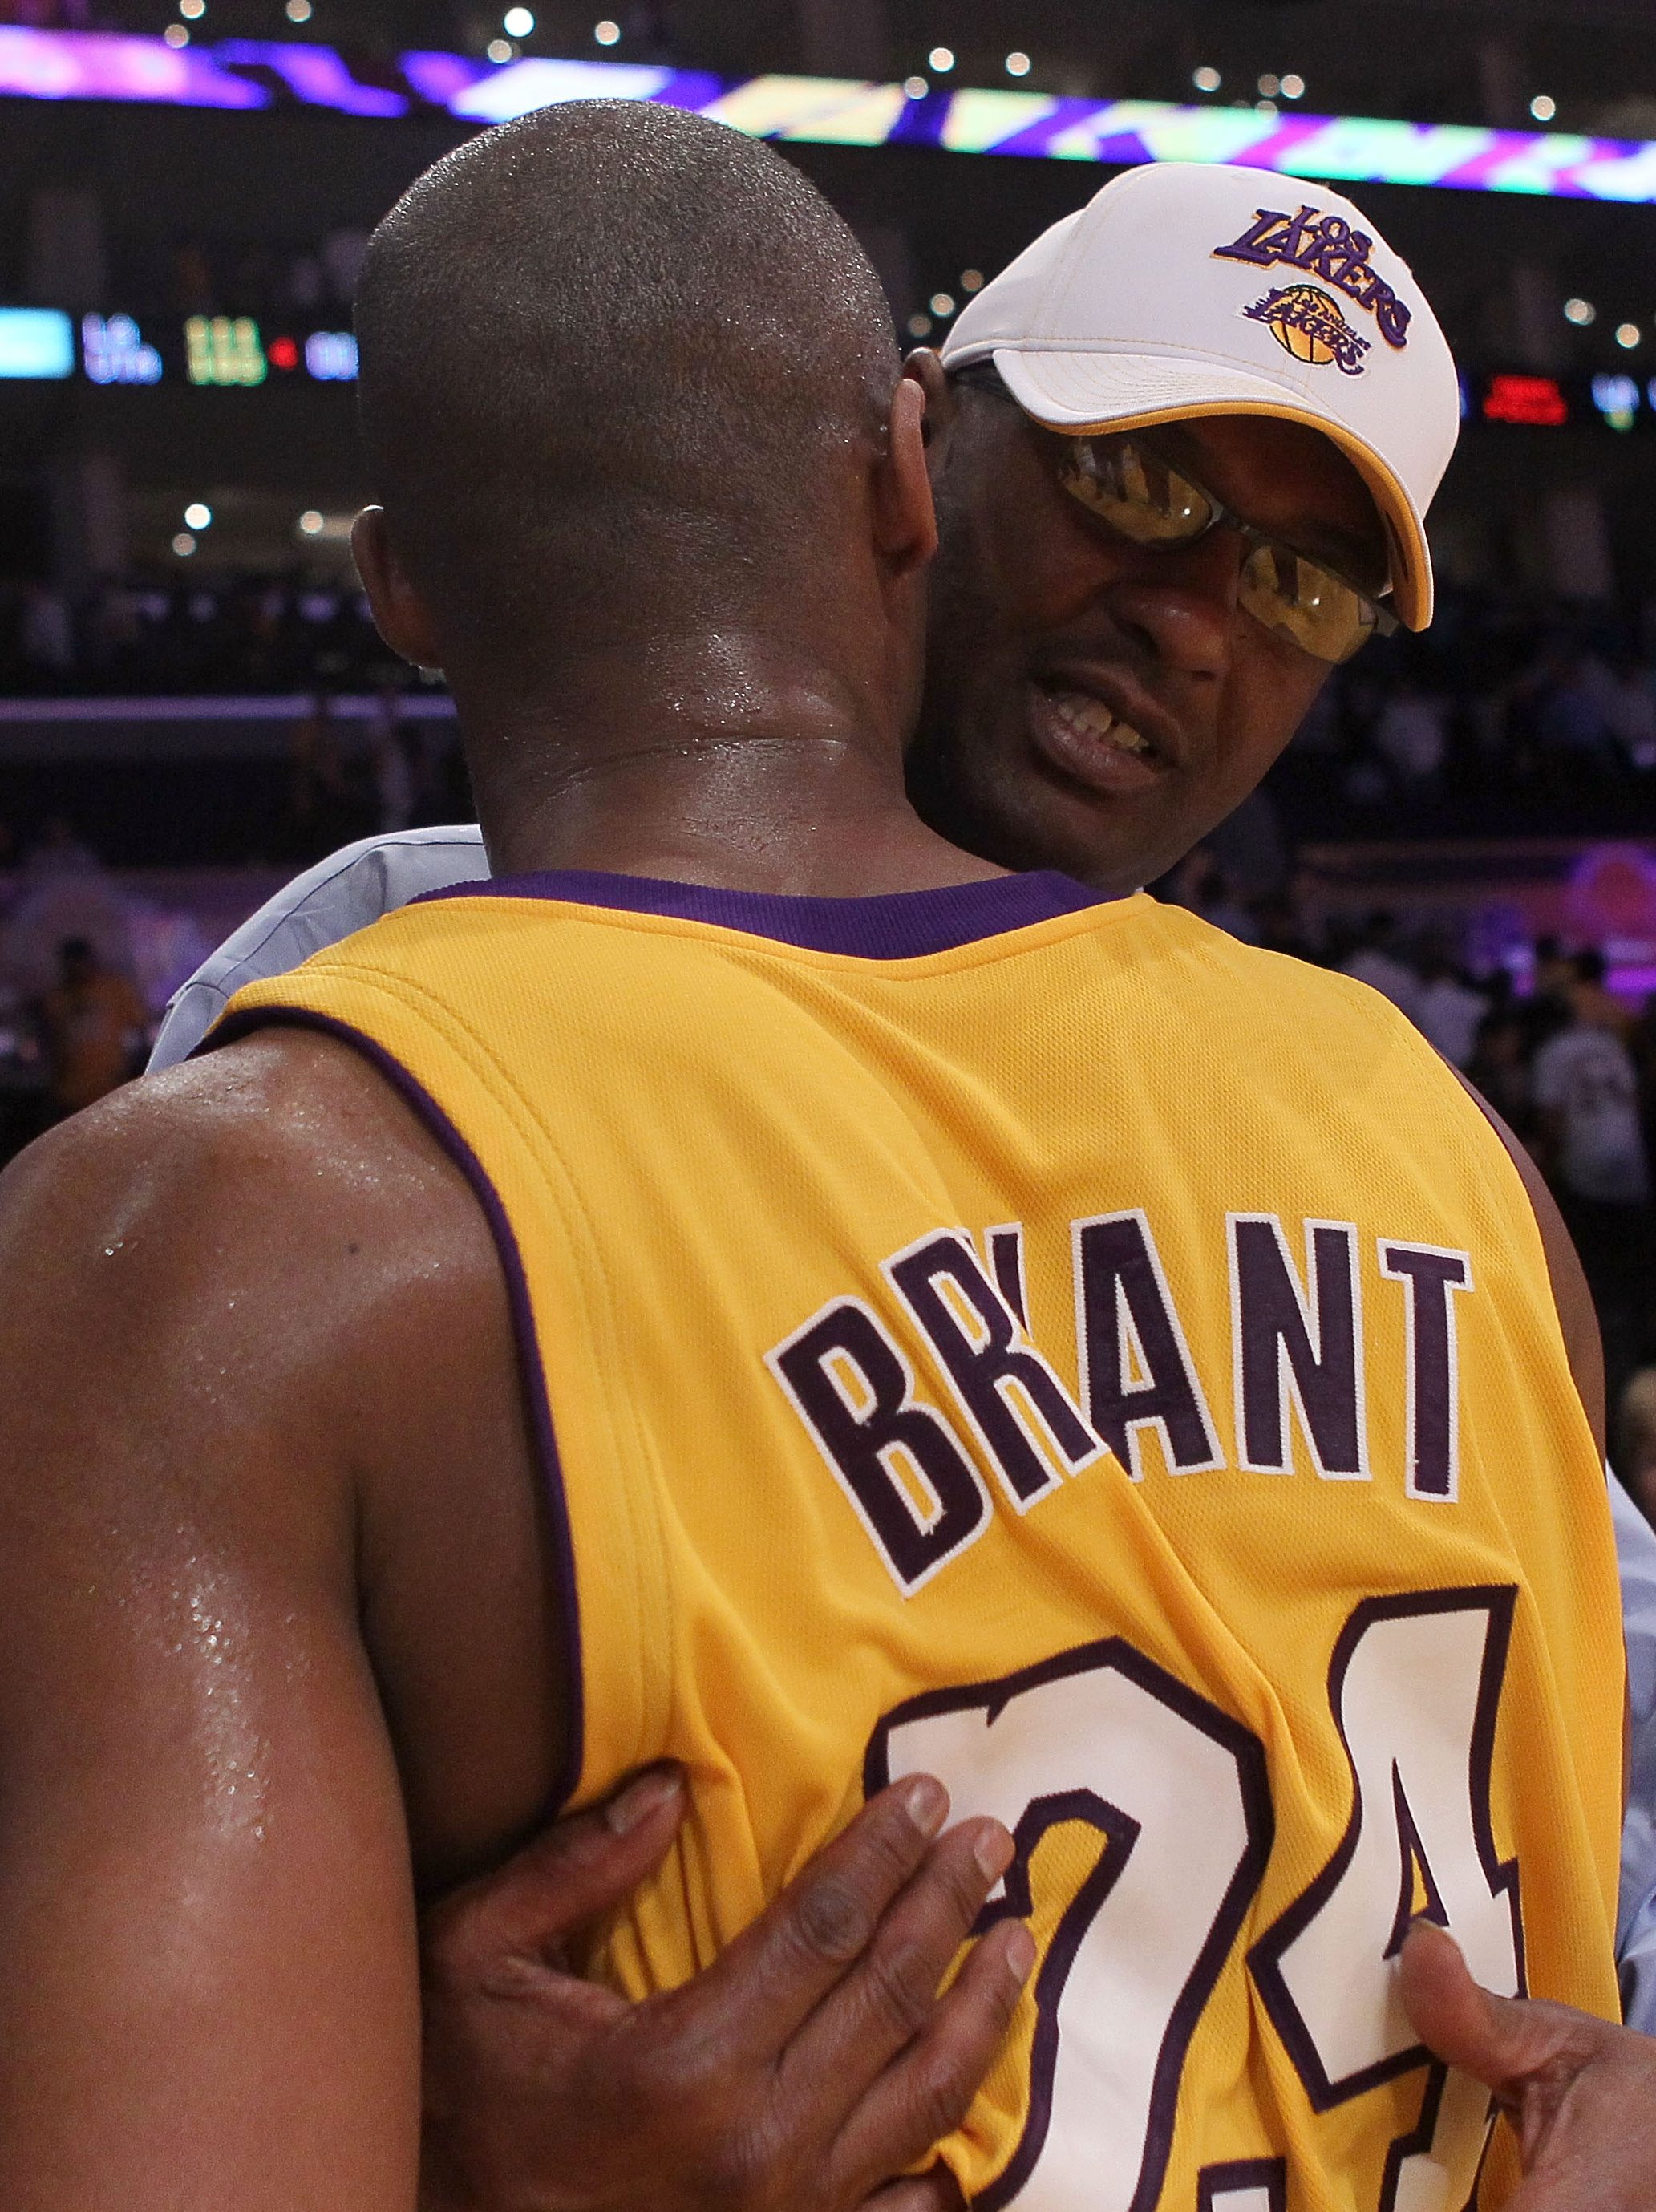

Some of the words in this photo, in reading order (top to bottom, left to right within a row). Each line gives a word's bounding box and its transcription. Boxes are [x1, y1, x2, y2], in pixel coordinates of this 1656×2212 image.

[1212, 208, 1411, 348] LAKERS
[763, 1208, 1475, 1600] BRANT
[862, 1584, 1528, 2212] 24
